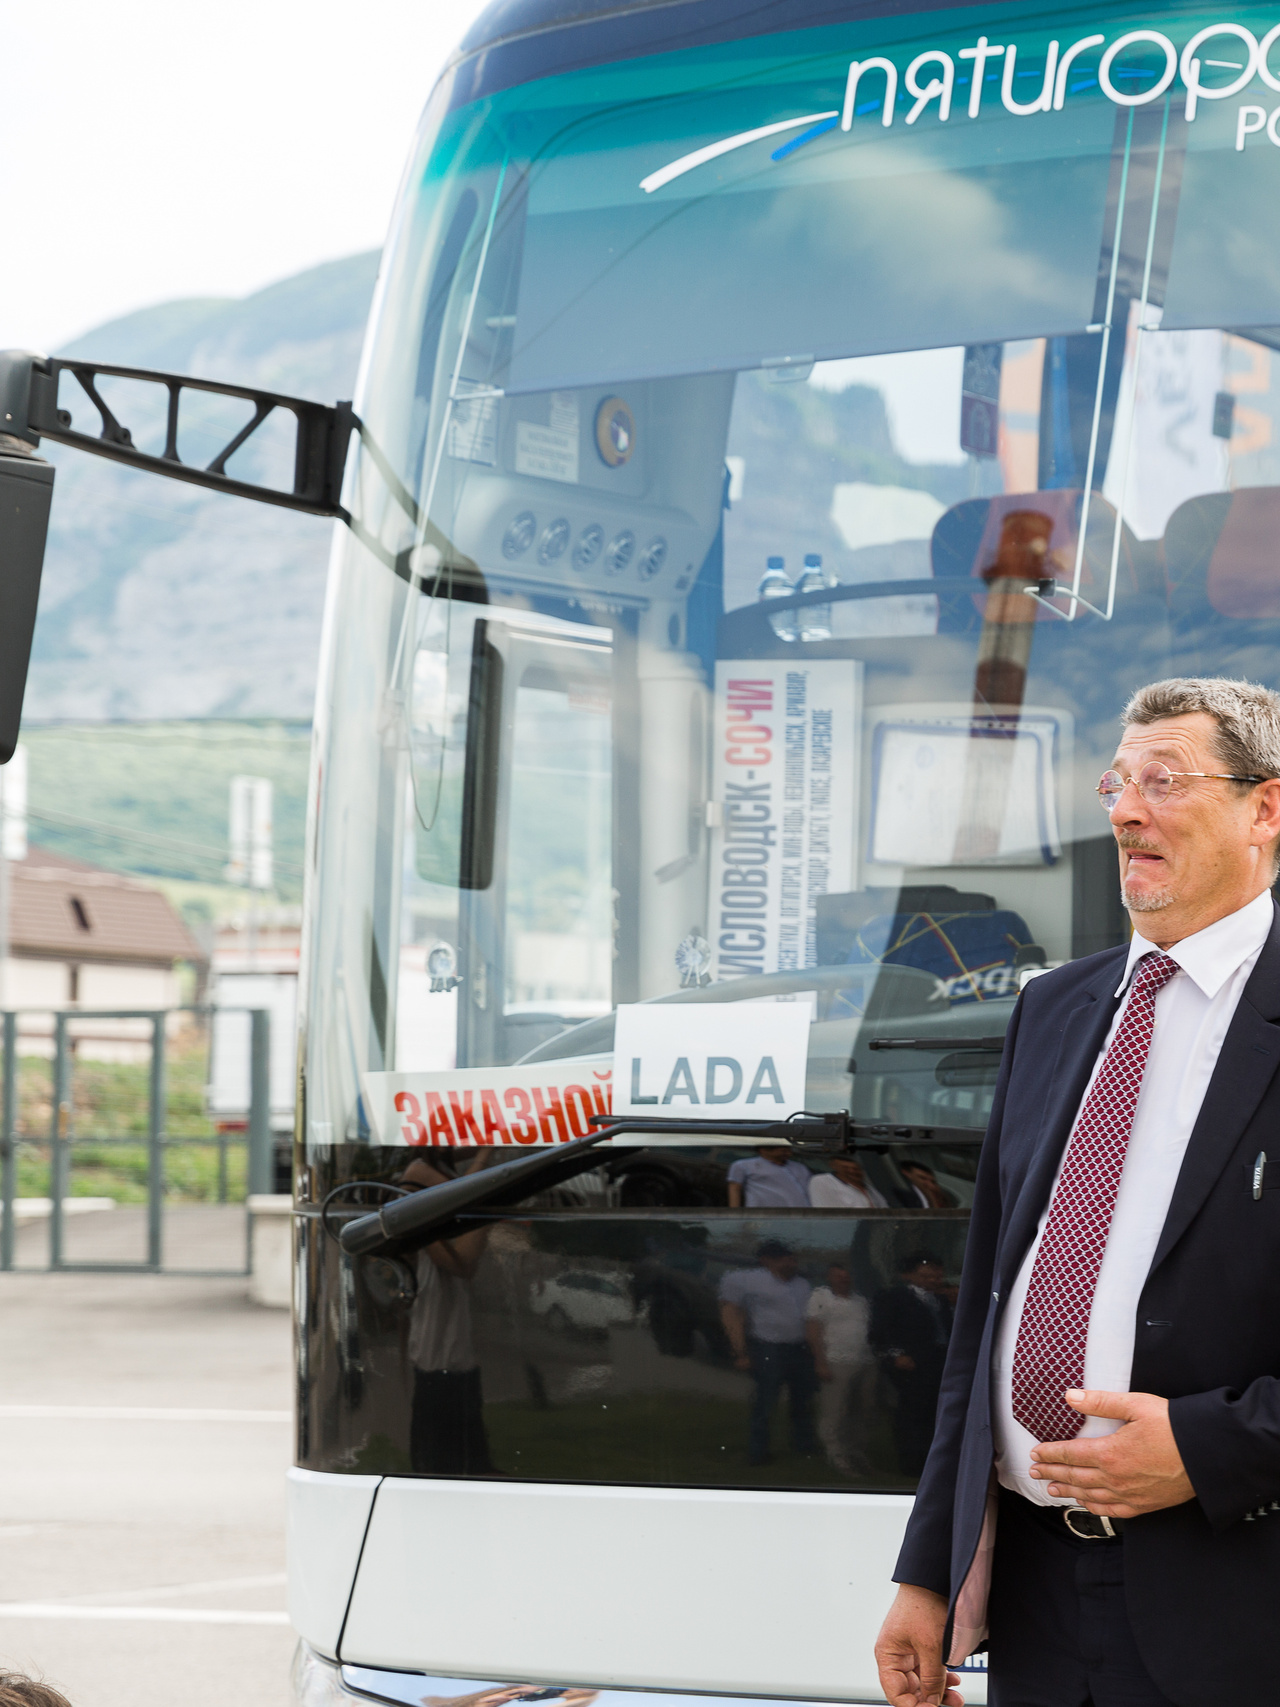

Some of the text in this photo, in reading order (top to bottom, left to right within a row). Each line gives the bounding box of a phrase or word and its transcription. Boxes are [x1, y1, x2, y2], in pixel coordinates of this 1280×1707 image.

[717, 679, 777, 981] ИСЛОВОДСК-СОЧИ
[394, 1069, 612, 1147] ЗАКАЗНОЙ
[630, 1056, 786, 1105] LADA
